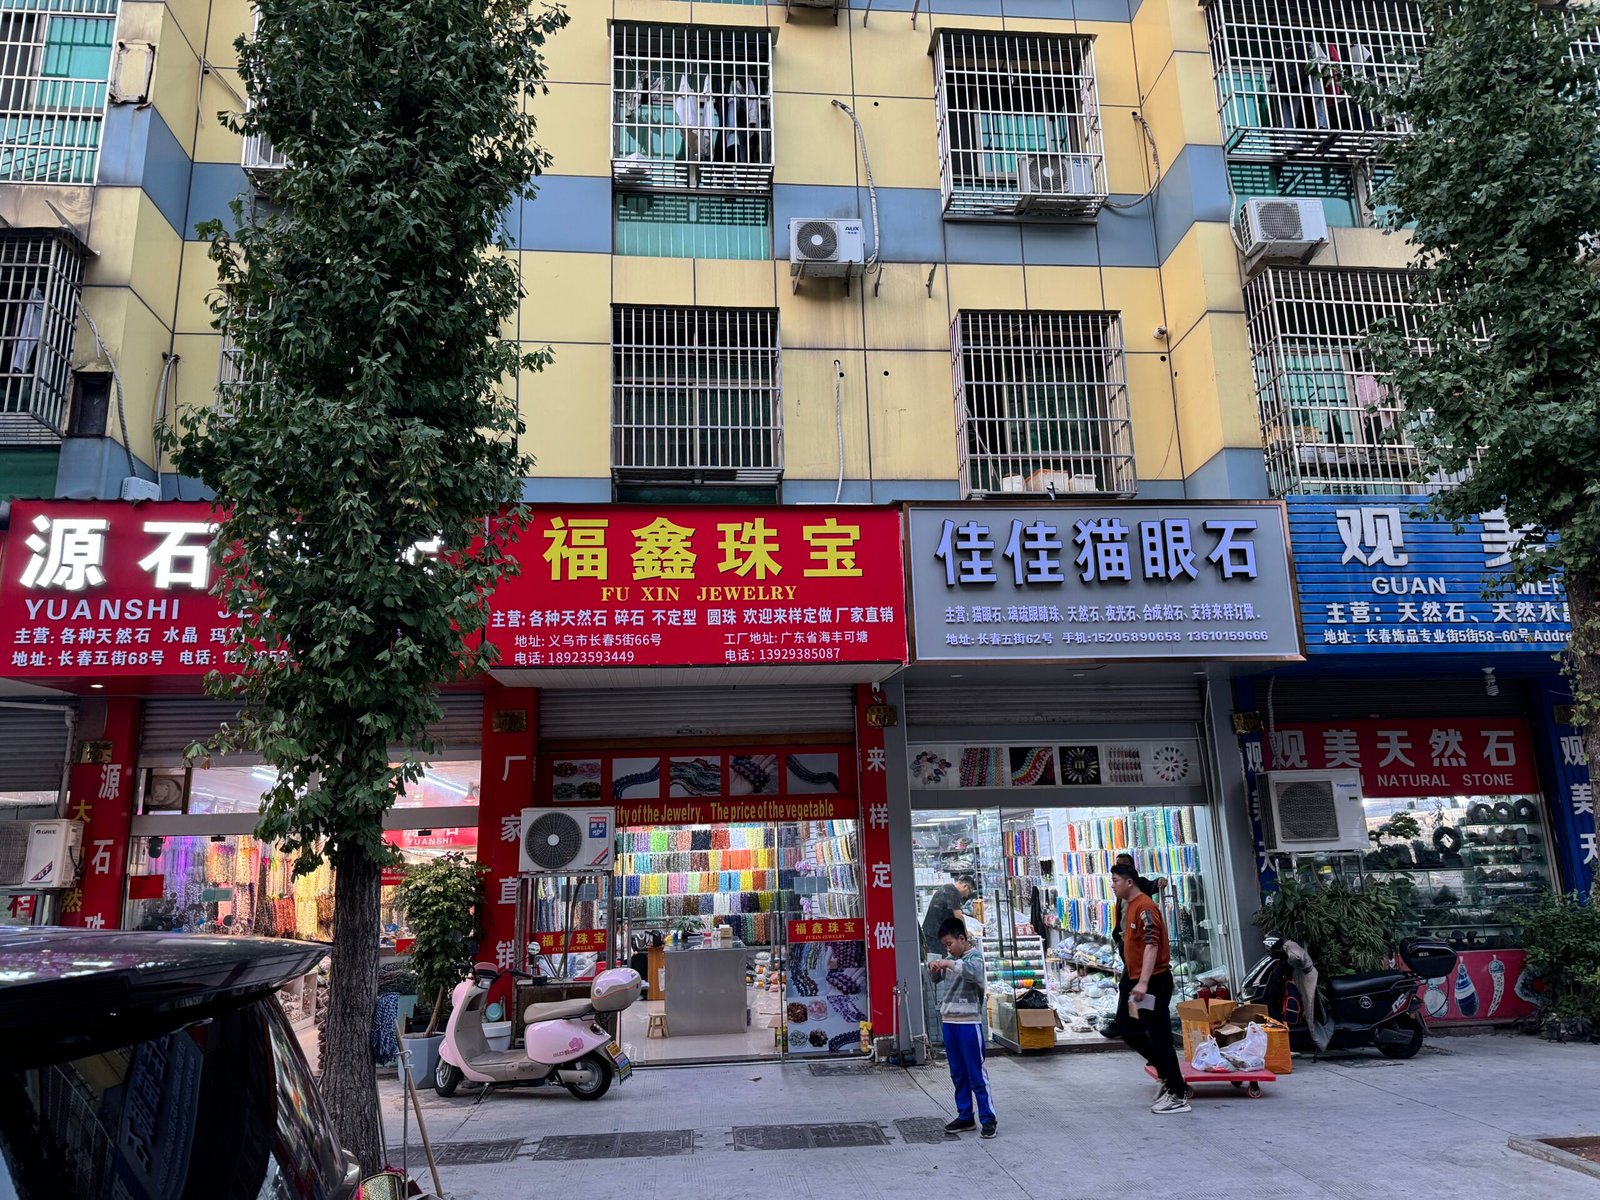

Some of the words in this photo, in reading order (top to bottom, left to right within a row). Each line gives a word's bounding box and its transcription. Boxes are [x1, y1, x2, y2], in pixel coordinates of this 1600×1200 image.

[19, 514, 220, 591] 源石
[543, 516, 863, 582] 福鑫珠宝
[936, 517, 1259, 587] 佳佳猫眼石
[601, 587, 630, 602] FU
[641, 586, 680, 602] XIN
[696, 585, 798, 602] JEWELRY
[1371, 576, 1447, 595] GUAN
[25, 598, 179, 621] YUANSHI
[614, 609, 645, 627] 碎石
[651, 608, 697, 627] 不定型
[707, 607, 737, 626] 圆珠
[743, 606, 832, 624] 欢迎来样定做
[835, 606, 894, 623] 厂家直销
[14, 627, 152, 645] 主营:各种天然石
[162, 626, 199, 643] 水晶
[1186, 630, 1269, 642] 13610159666
[1270, 728, 1517, 769] 观美天然石
[1377, 774, 1451, 788] NATURAL
[1463, 773, 1515, 787] STONE
[710, 802, 728, 820] The
[730, 801, 756, 822] price
[757, 801, 768, 818] of
[768, 802, 785, 818] the
[785, 799, 834, 820] vegetable
[866, 746, 896, 951] 来样定做
[496, 755, 527, 969] 厂家直销
[795, 921, 856, 935] 福鑫珠宝
